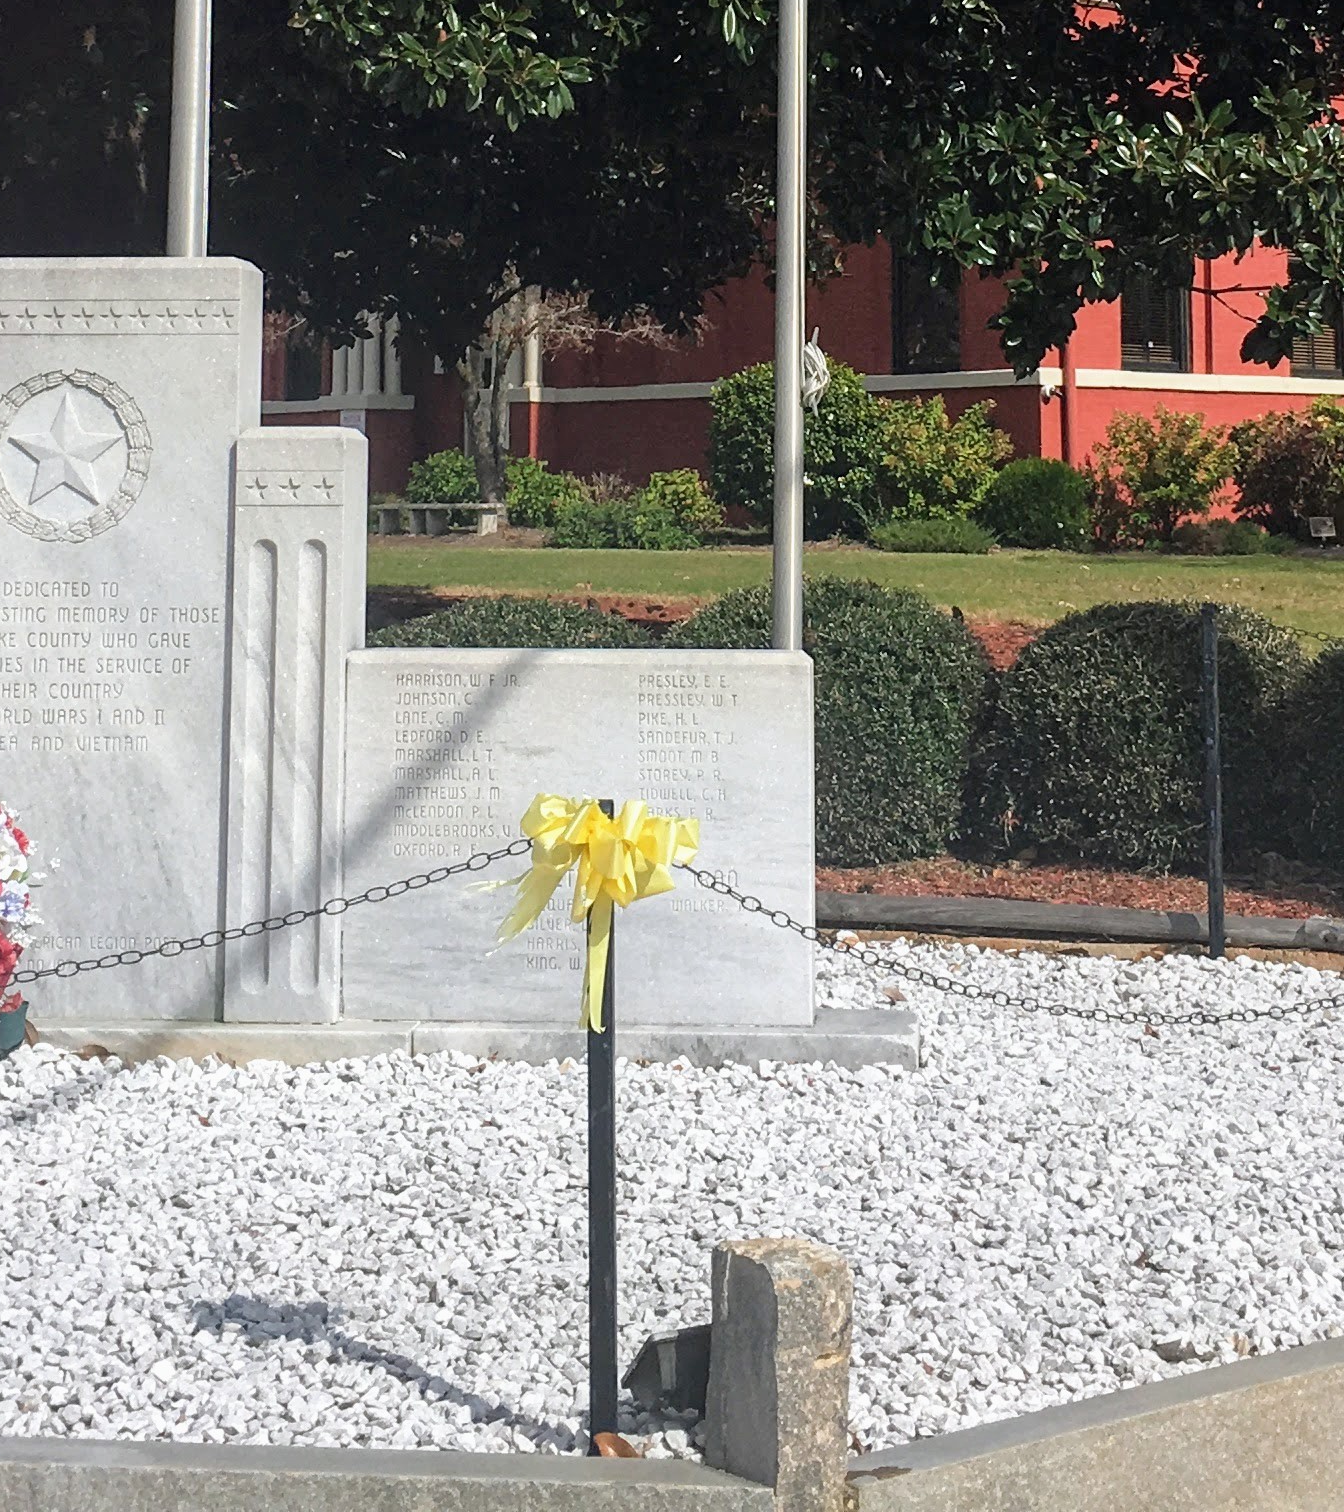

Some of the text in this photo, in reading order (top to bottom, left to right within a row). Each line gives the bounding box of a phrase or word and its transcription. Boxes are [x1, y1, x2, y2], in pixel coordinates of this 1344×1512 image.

[3, 581, 118, 598] DEDICATED TO
[58, 607, 129, 623] MEMORY
[140, 607, 159, 623] OF
[169, 607, 219, 623] THOSE
[27, 632, 91, 648] COUNTY
[102, 633, 137, 648] WHO
[148, 633, 191, 648] GAVE
[33, 657, 48, 672] IN
[58, 658, 86, 673] THE
[96, 658, 162, 674] SERVICE
[172, 658, 191, 674] OF
[49, 683, 123, 699] COUNTRY
[42, 708, 87, 725] WARS
[97, 709, 102, 725] I
[112, 709, 145, 725] AND
[155, 709, 165, 725] II
[31, 735, 64, 751] AND
[77, 735, 148, 752] VIETNAM
